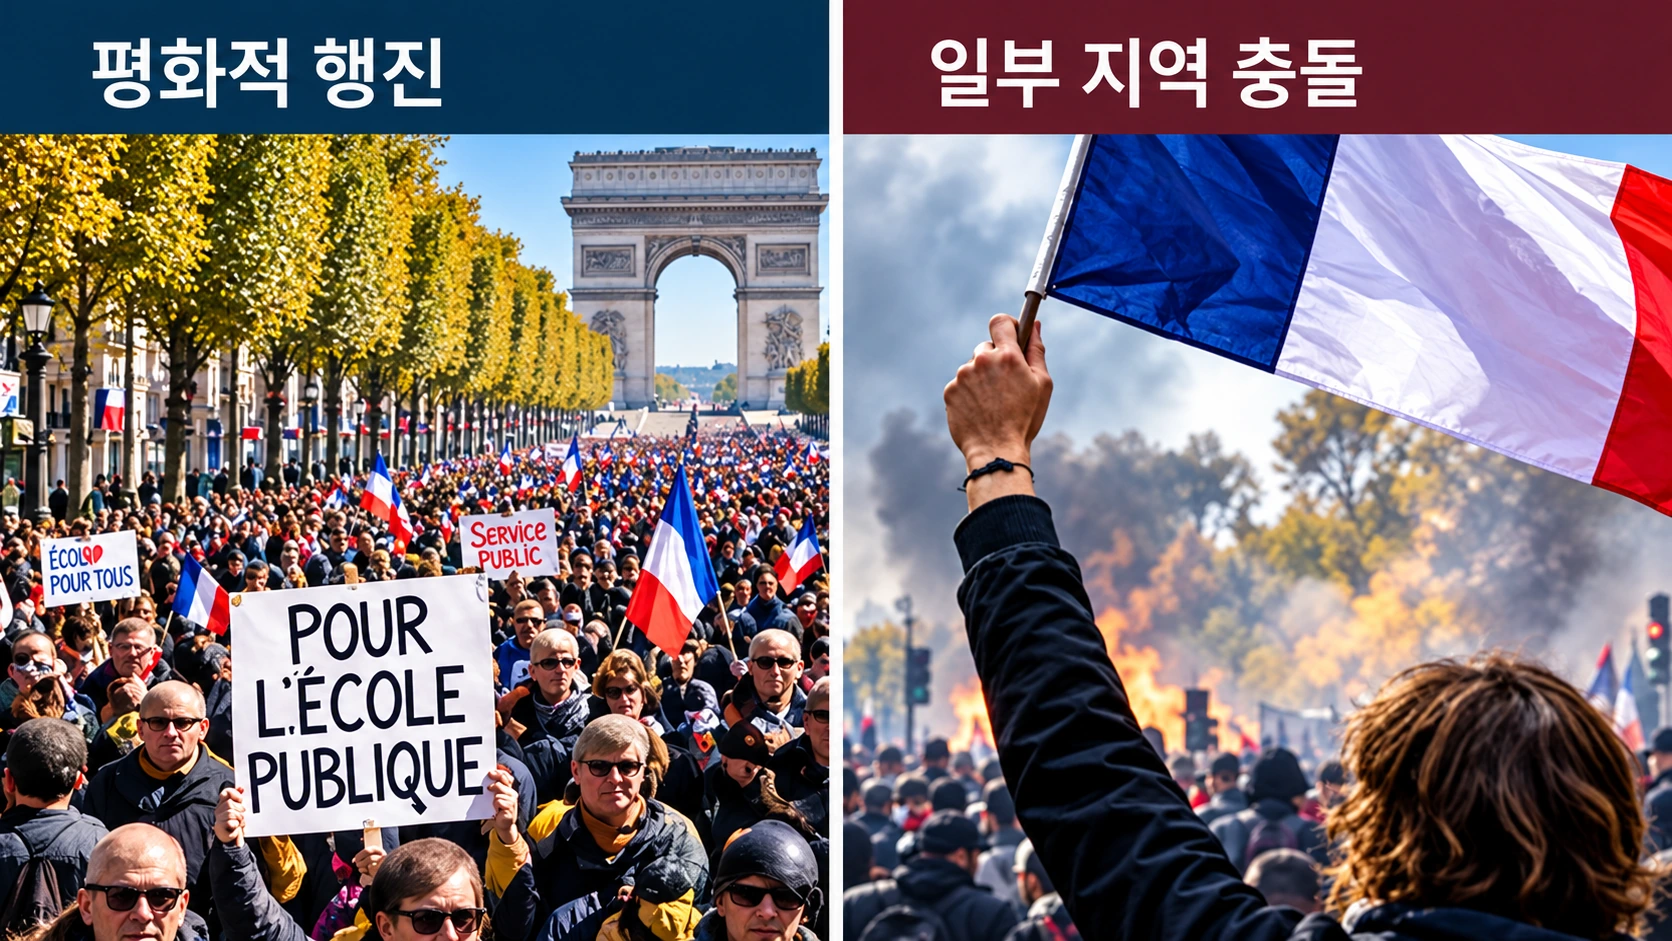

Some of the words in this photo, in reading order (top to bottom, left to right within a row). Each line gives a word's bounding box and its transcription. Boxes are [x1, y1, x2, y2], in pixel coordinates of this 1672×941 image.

[50, 571, 92, 595] POUR
[93, 565, 134, 590] TOUS
[287, 595, 433, 665] POUR
[247, 735, 484, 815] PUBLIQUE
